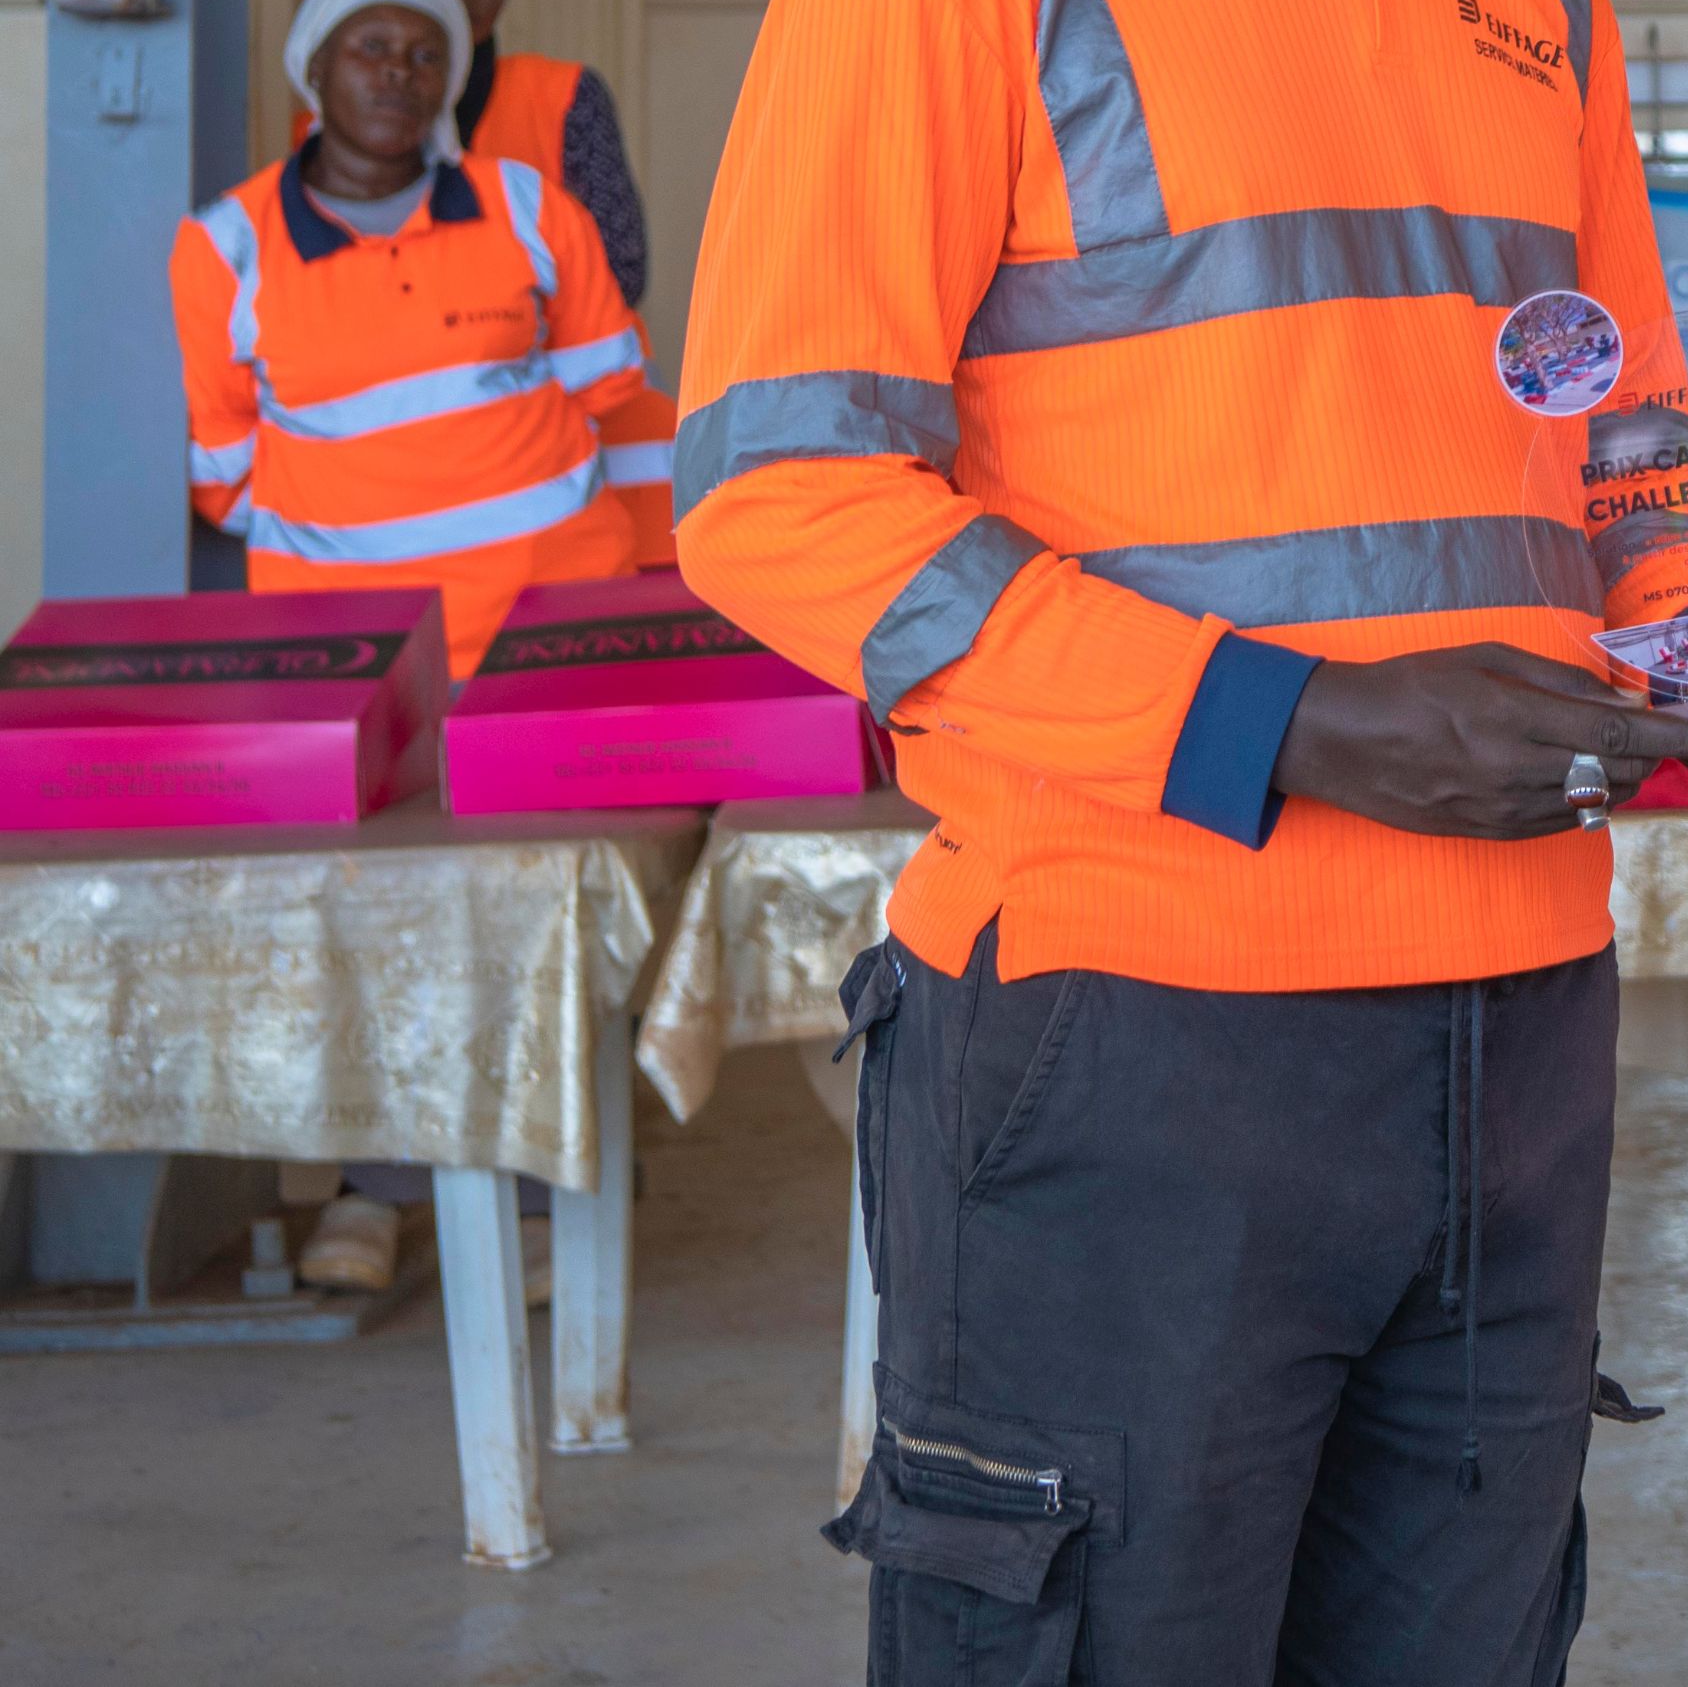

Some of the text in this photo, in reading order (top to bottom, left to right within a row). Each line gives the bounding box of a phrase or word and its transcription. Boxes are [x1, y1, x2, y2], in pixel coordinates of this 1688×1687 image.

[1486, 13, 1564, 69] EIFFAGE
[1580, 452, 1645, 487] PRIX
[1643, 590, 1664, 602] MS
